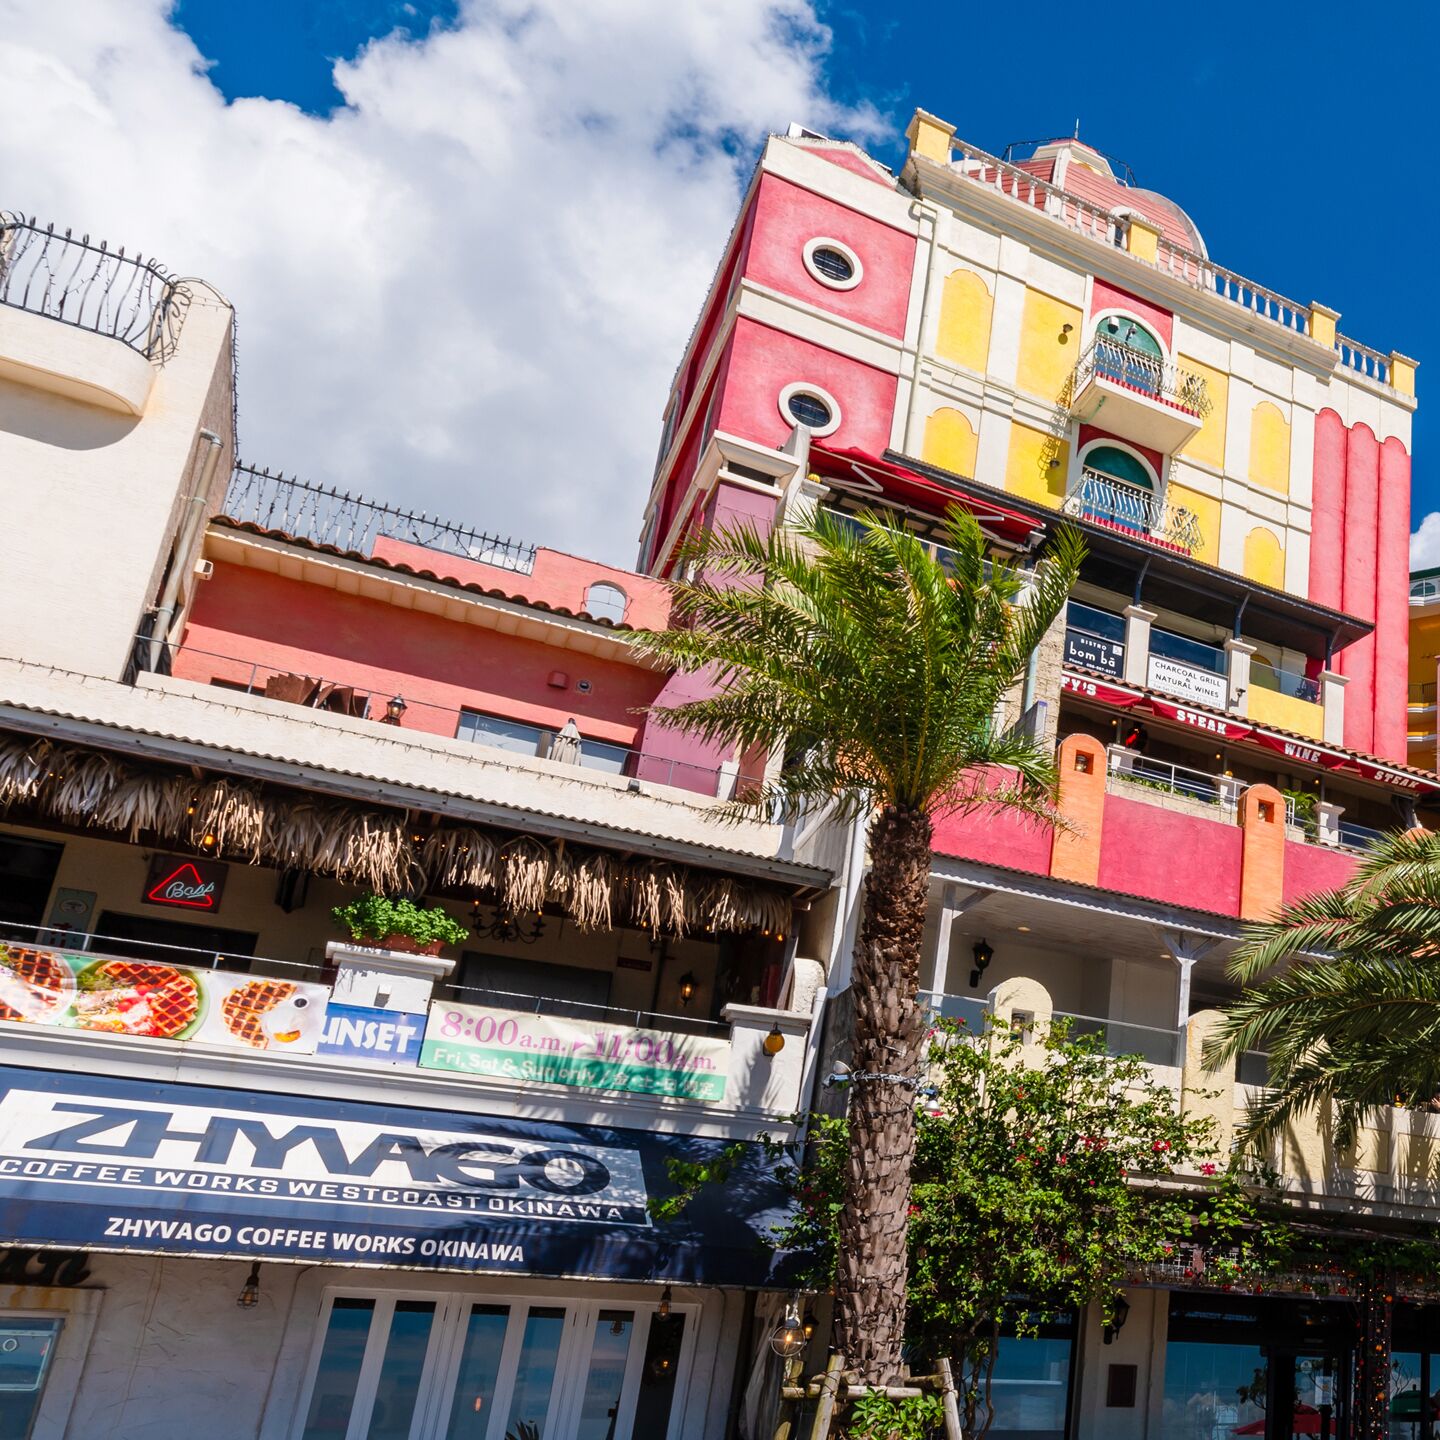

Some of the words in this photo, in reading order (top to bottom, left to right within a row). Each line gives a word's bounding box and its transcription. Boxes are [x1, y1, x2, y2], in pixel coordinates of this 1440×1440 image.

[1070, 642, 1095, 661] bom
[1080, 638, 1106, 650] BISTRO
[1155, 662, 1196, 679] CHARCOAL
[1200, 676, 1221, 687] GRILL
[1156, 674, 1191, 689] NATURAL
[1195, 686, 1219, 698] WINES
[1176, 710, 1226, 734] STEAK
[1285, 743, 1321, 762] WINE
[1374, 771, 1420, 788] STEAK
[166, 882, 214, 898] Bass
[470, 1053, 498, 1069] Sat
[502, 1058, 517, 1071] &
[522, 1060, 555, 1076] Sun
[559, 1068, 596, 1082] only
[23, 1102, 610, 1196] ZHYVAGO
[1, 1160, 144, 1183] COFFEE
[155, 1170, 279, 1192] WORKS
[289, 1182, 481, 1208] WESTCOAST
[489, 1198, 624, 1220] OKINAWA
[104, 1217, 232, 1242] ZHYVAGO
[237, 1227, 327, 1249] COFFEE
[332, 1233, 416, 1254] WORKS
[420, 1239, 524, 1262] OKINAWA
